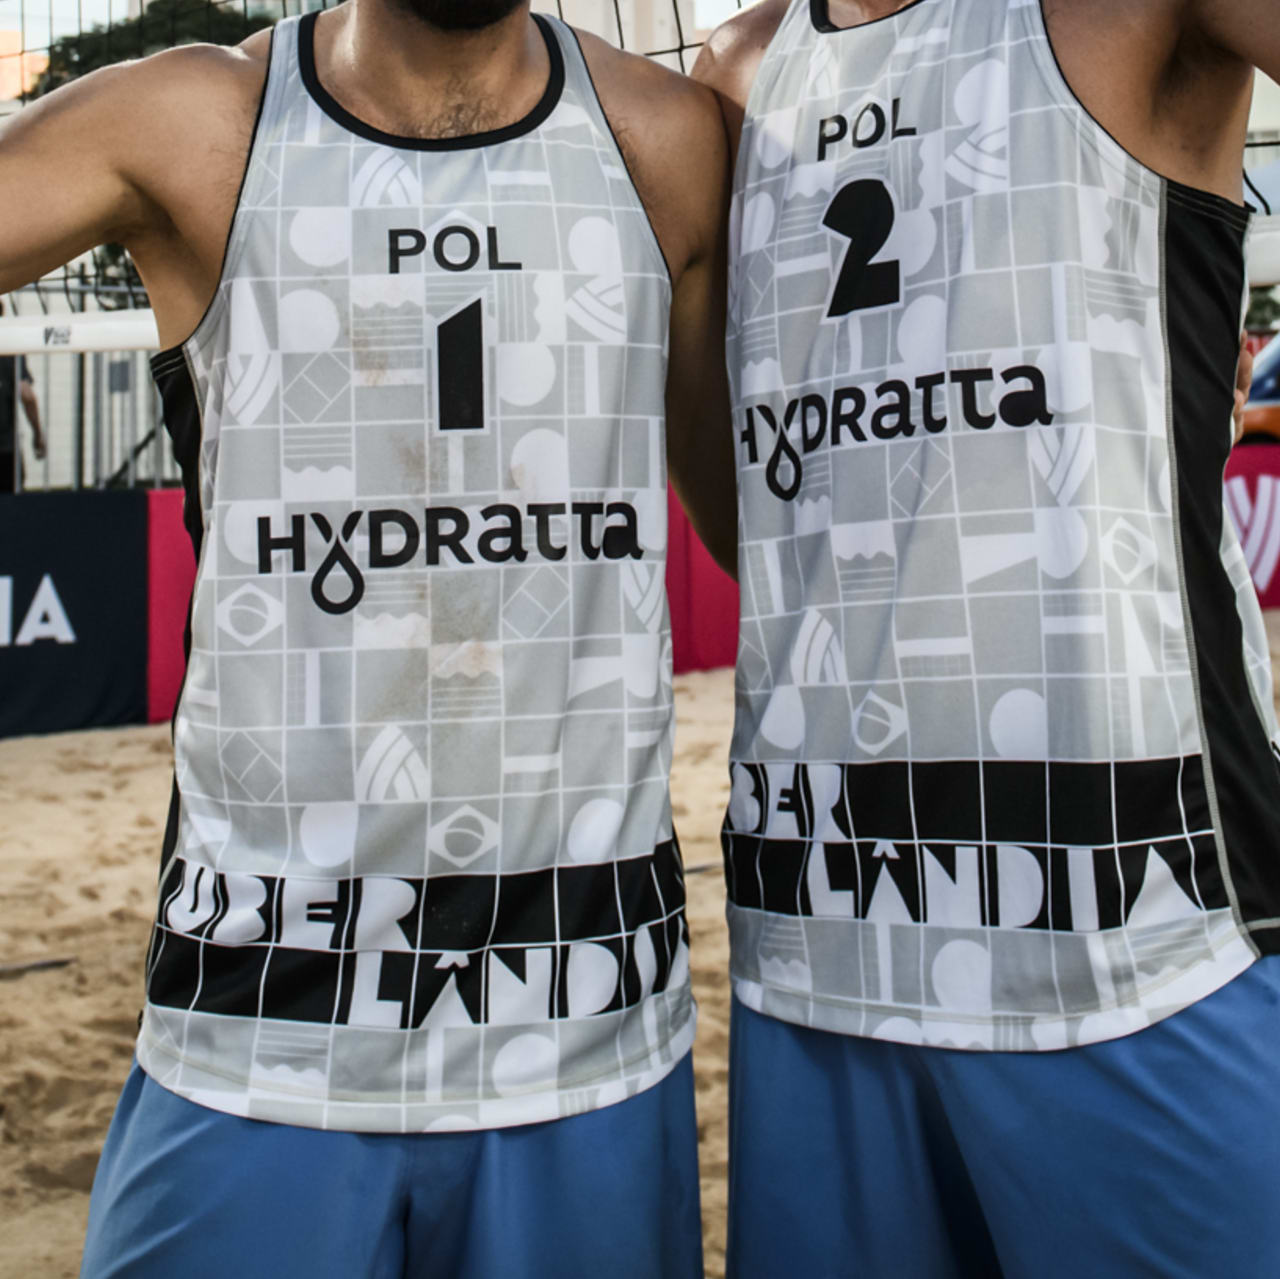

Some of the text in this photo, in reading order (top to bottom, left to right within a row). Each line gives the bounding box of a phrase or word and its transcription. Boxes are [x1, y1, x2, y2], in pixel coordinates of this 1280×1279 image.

[817, 97, 917, 162] POL
[388, 225, 522, 274] POL
[822, 177, 901, 319] 2
[436, 297, 485, 431] 1
